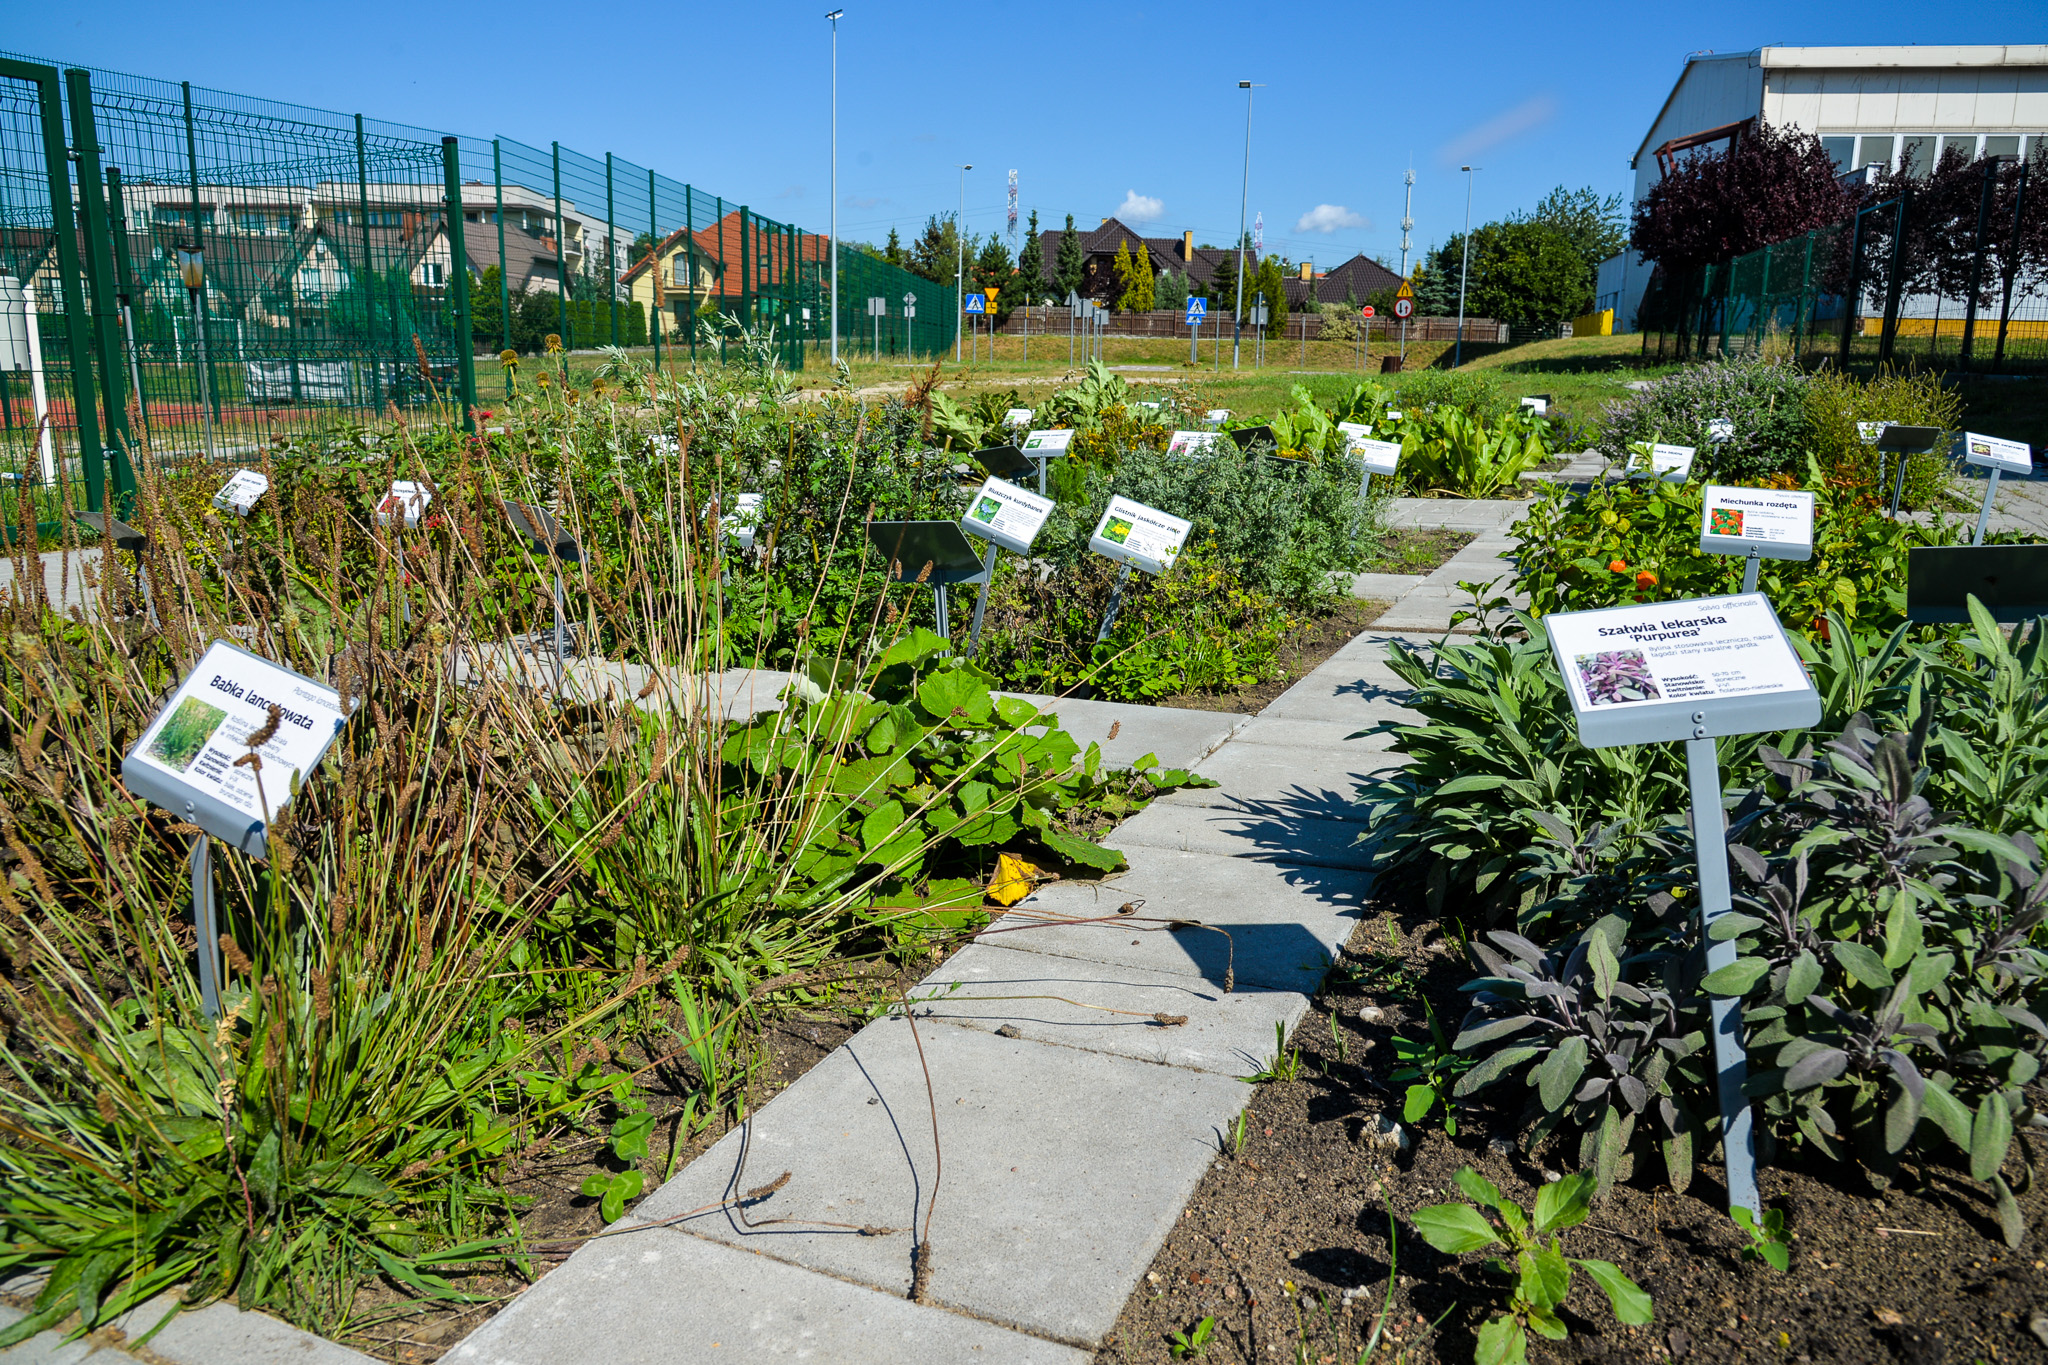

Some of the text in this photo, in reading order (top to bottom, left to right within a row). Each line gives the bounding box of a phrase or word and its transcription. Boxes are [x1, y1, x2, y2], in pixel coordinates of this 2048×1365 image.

[1720, 498, 1764, 506] Miechunka
[1722, 600, 1758, 609] officinalis
[1598, 616, 1727, 636] Szałwia lekarska
[1674, 641, 1713, 649] stosowana
[1661, 674, 1698, 682] Wysokość:
[1666, 685, 1705, 693] Kwitnienie:
[210, 675, 244, 699] Babka
[245, 690, 314, 730] lancowata
